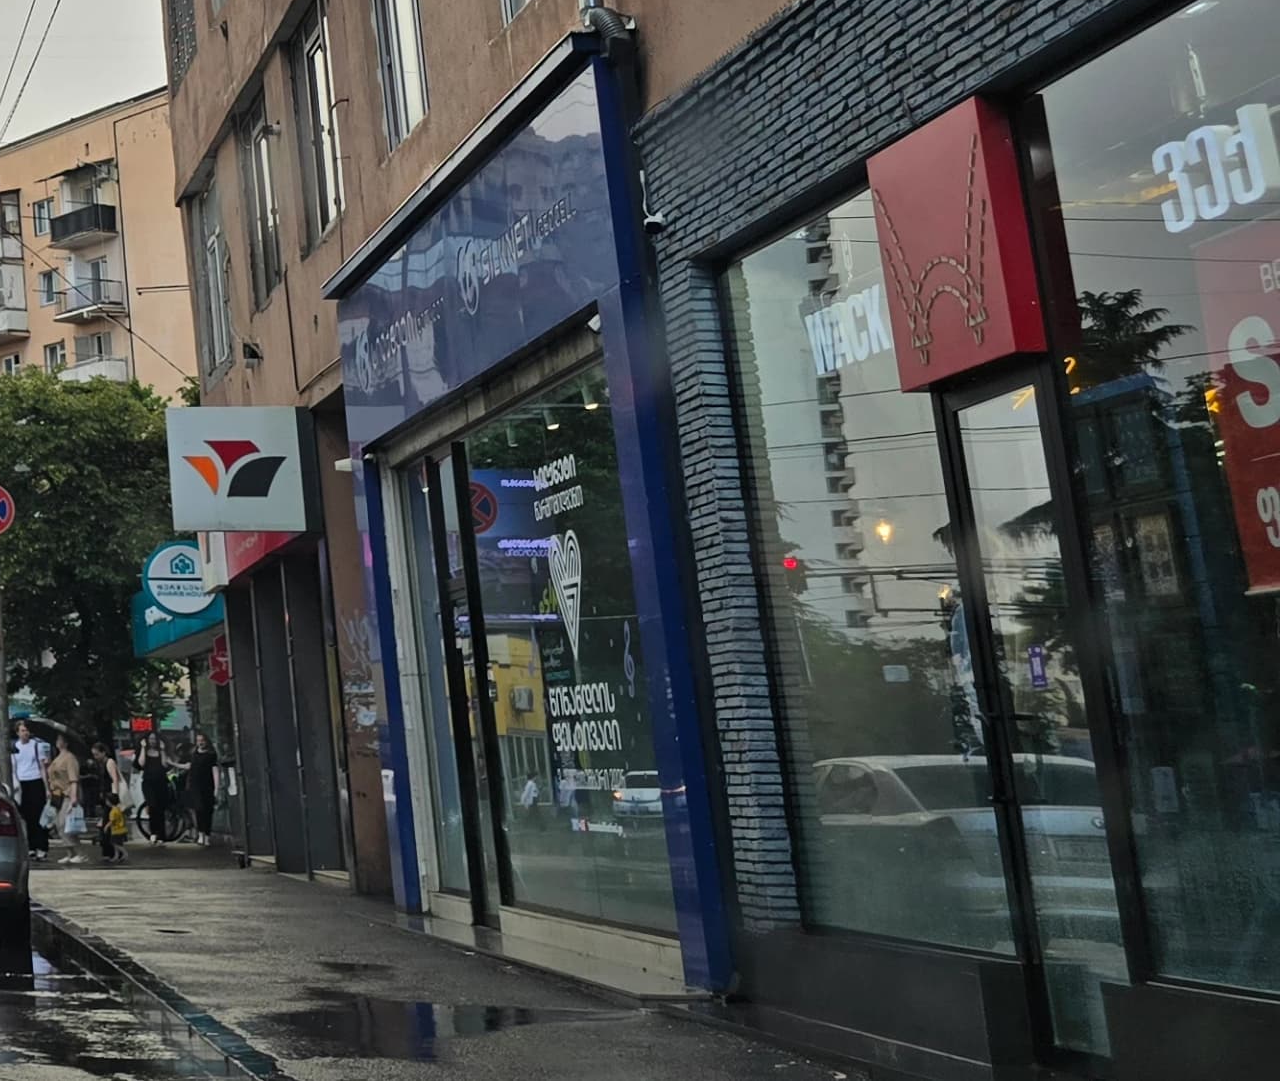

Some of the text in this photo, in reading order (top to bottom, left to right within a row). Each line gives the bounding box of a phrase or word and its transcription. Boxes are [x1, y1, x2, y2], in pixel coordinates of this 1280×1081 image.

[481, 214, 530, 286] SILKNET
[804, 283, 891, 376] WACK
[548, 682, 616, 717] წინანდლის
[552, 719, 622, 752] ფესტივალი
